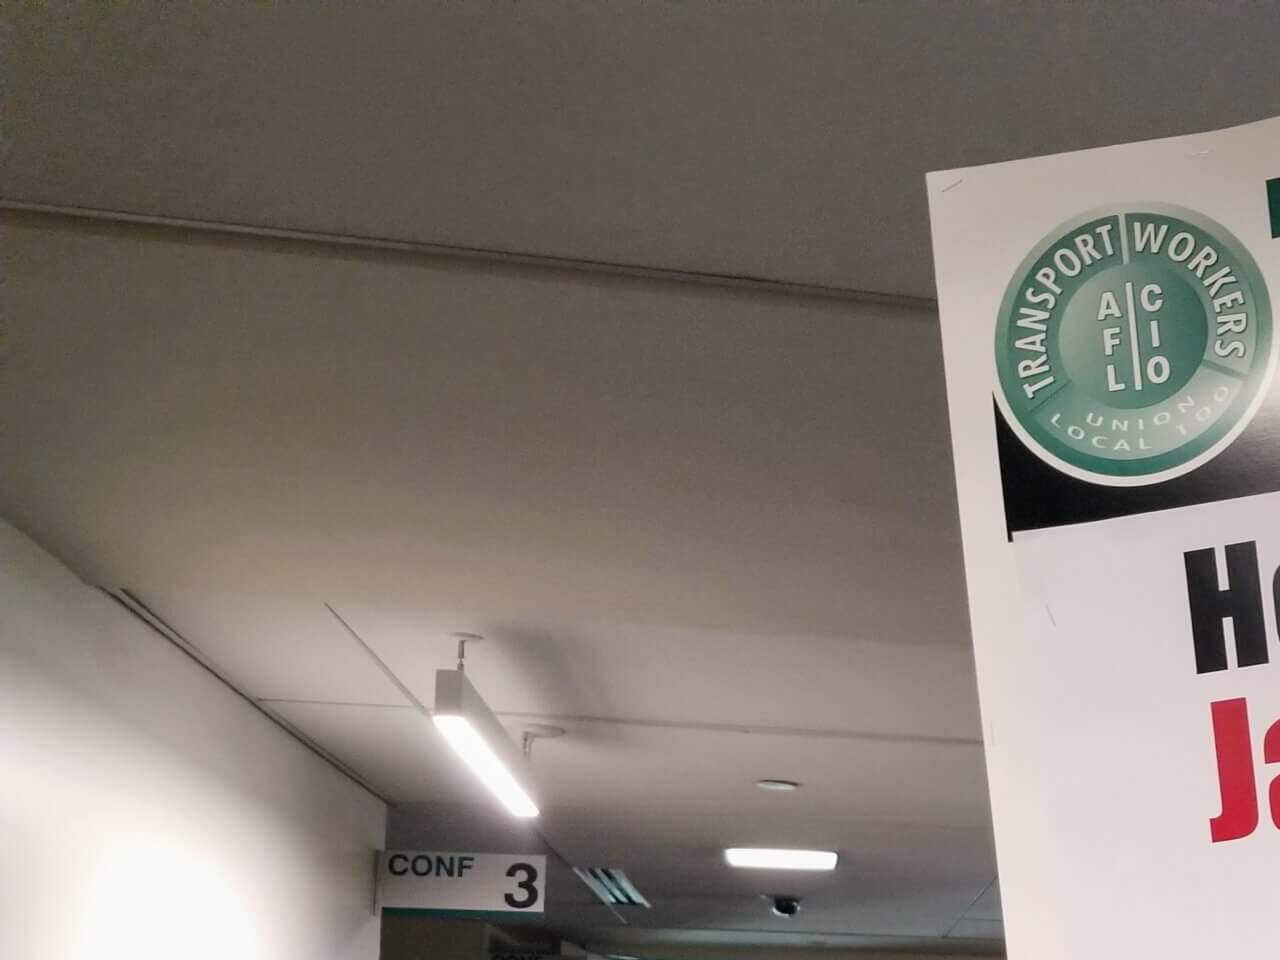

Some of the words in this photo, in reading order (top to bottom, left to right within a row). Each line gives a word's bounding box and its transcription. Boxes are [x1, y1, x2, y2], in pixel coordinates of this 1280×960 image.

[1015, 223, 1117, 399] TRANSPORT
[1133, 222, 1248, 359] WORKERS
[1050, 413, 1152, 451] LOCAL
[1176, 385, 1230, 435] 100
[1086, 396, 1194, 431] UNION
[388, 854, 474, 878] CONF
[504, 862, 539, 909] 3
